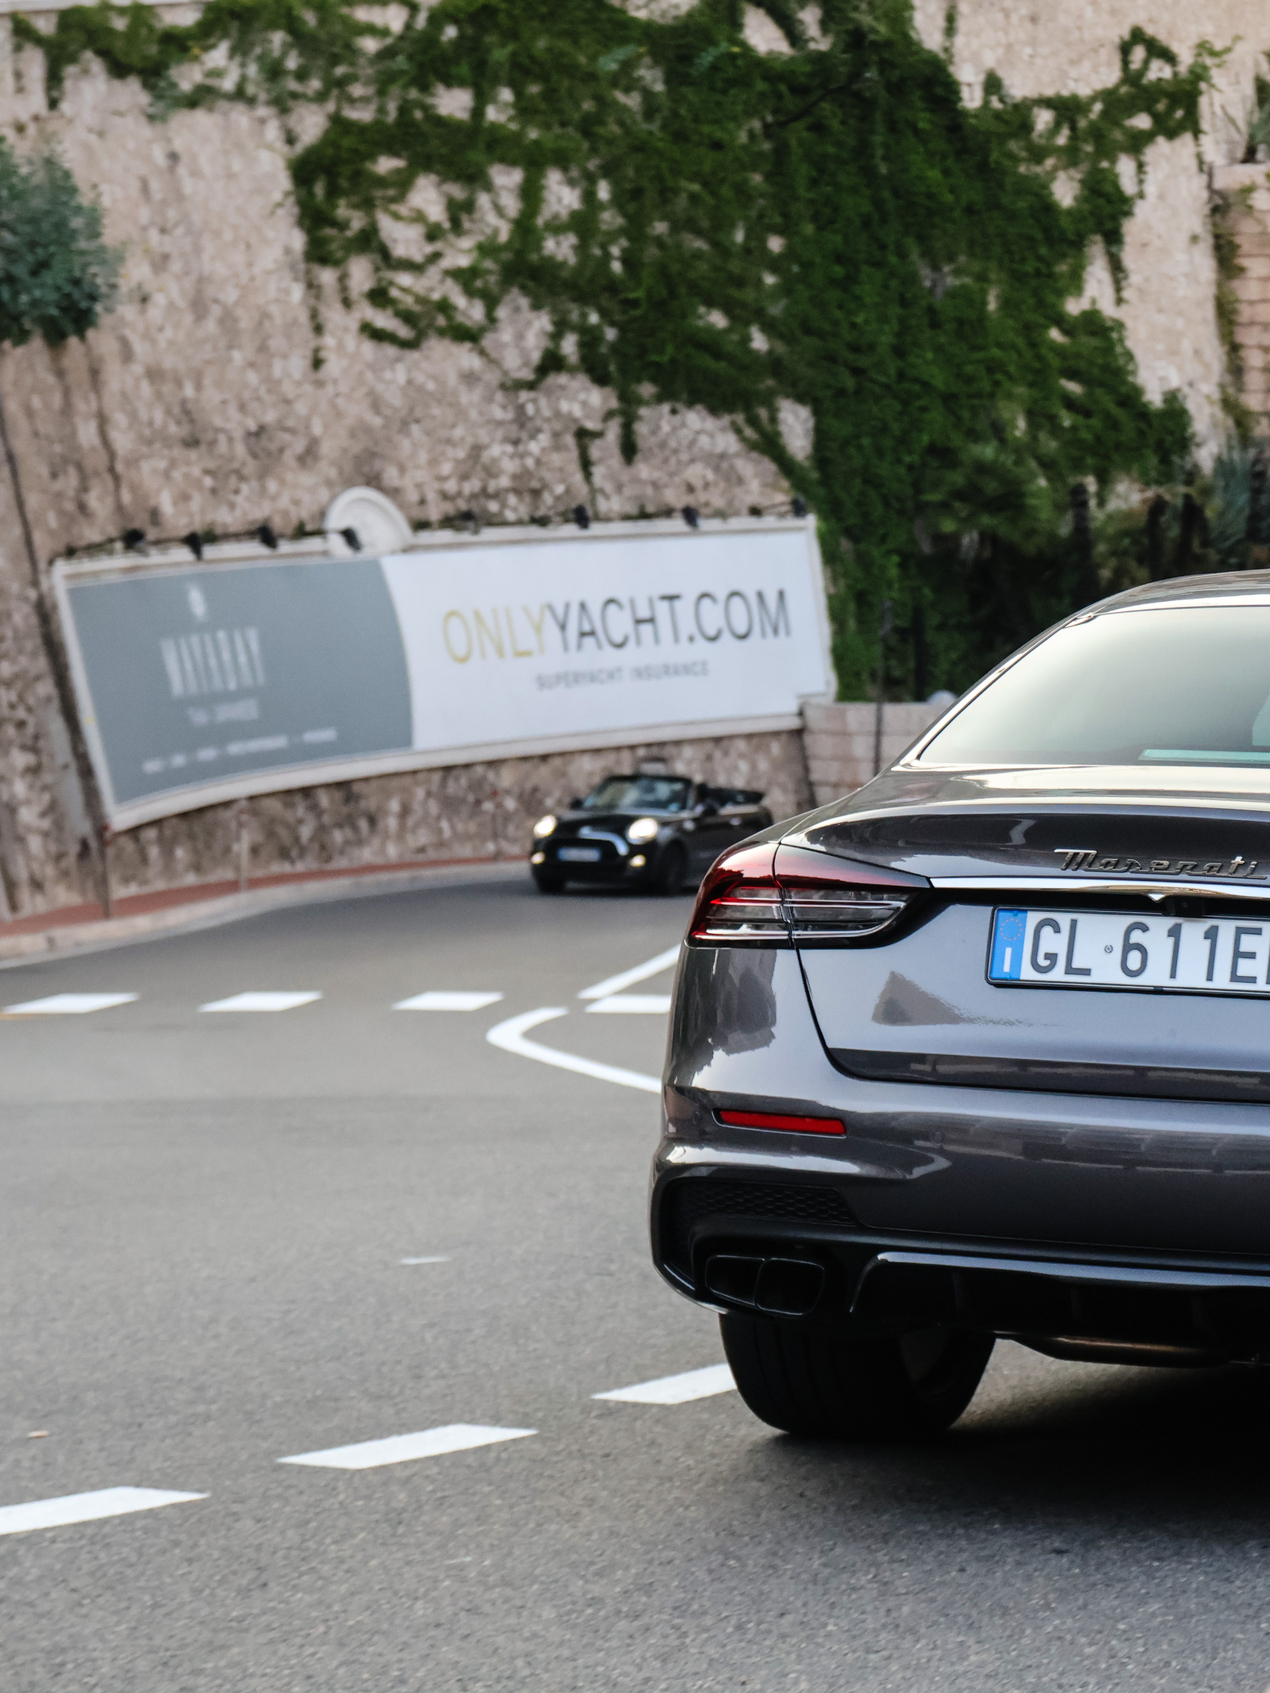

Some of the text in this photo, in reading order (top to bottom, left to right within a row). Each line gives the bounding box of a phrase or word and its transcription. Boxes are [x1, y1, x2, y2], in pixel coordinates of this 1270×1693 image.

[441, 588, 792, 664] ONLYYACHT.COM
[536, 660, 710, 691] SUPERYACHT INSURANCE
[1053, 848, 1268, 880] Maserati
[1029, 917, 1092, 977] GL
